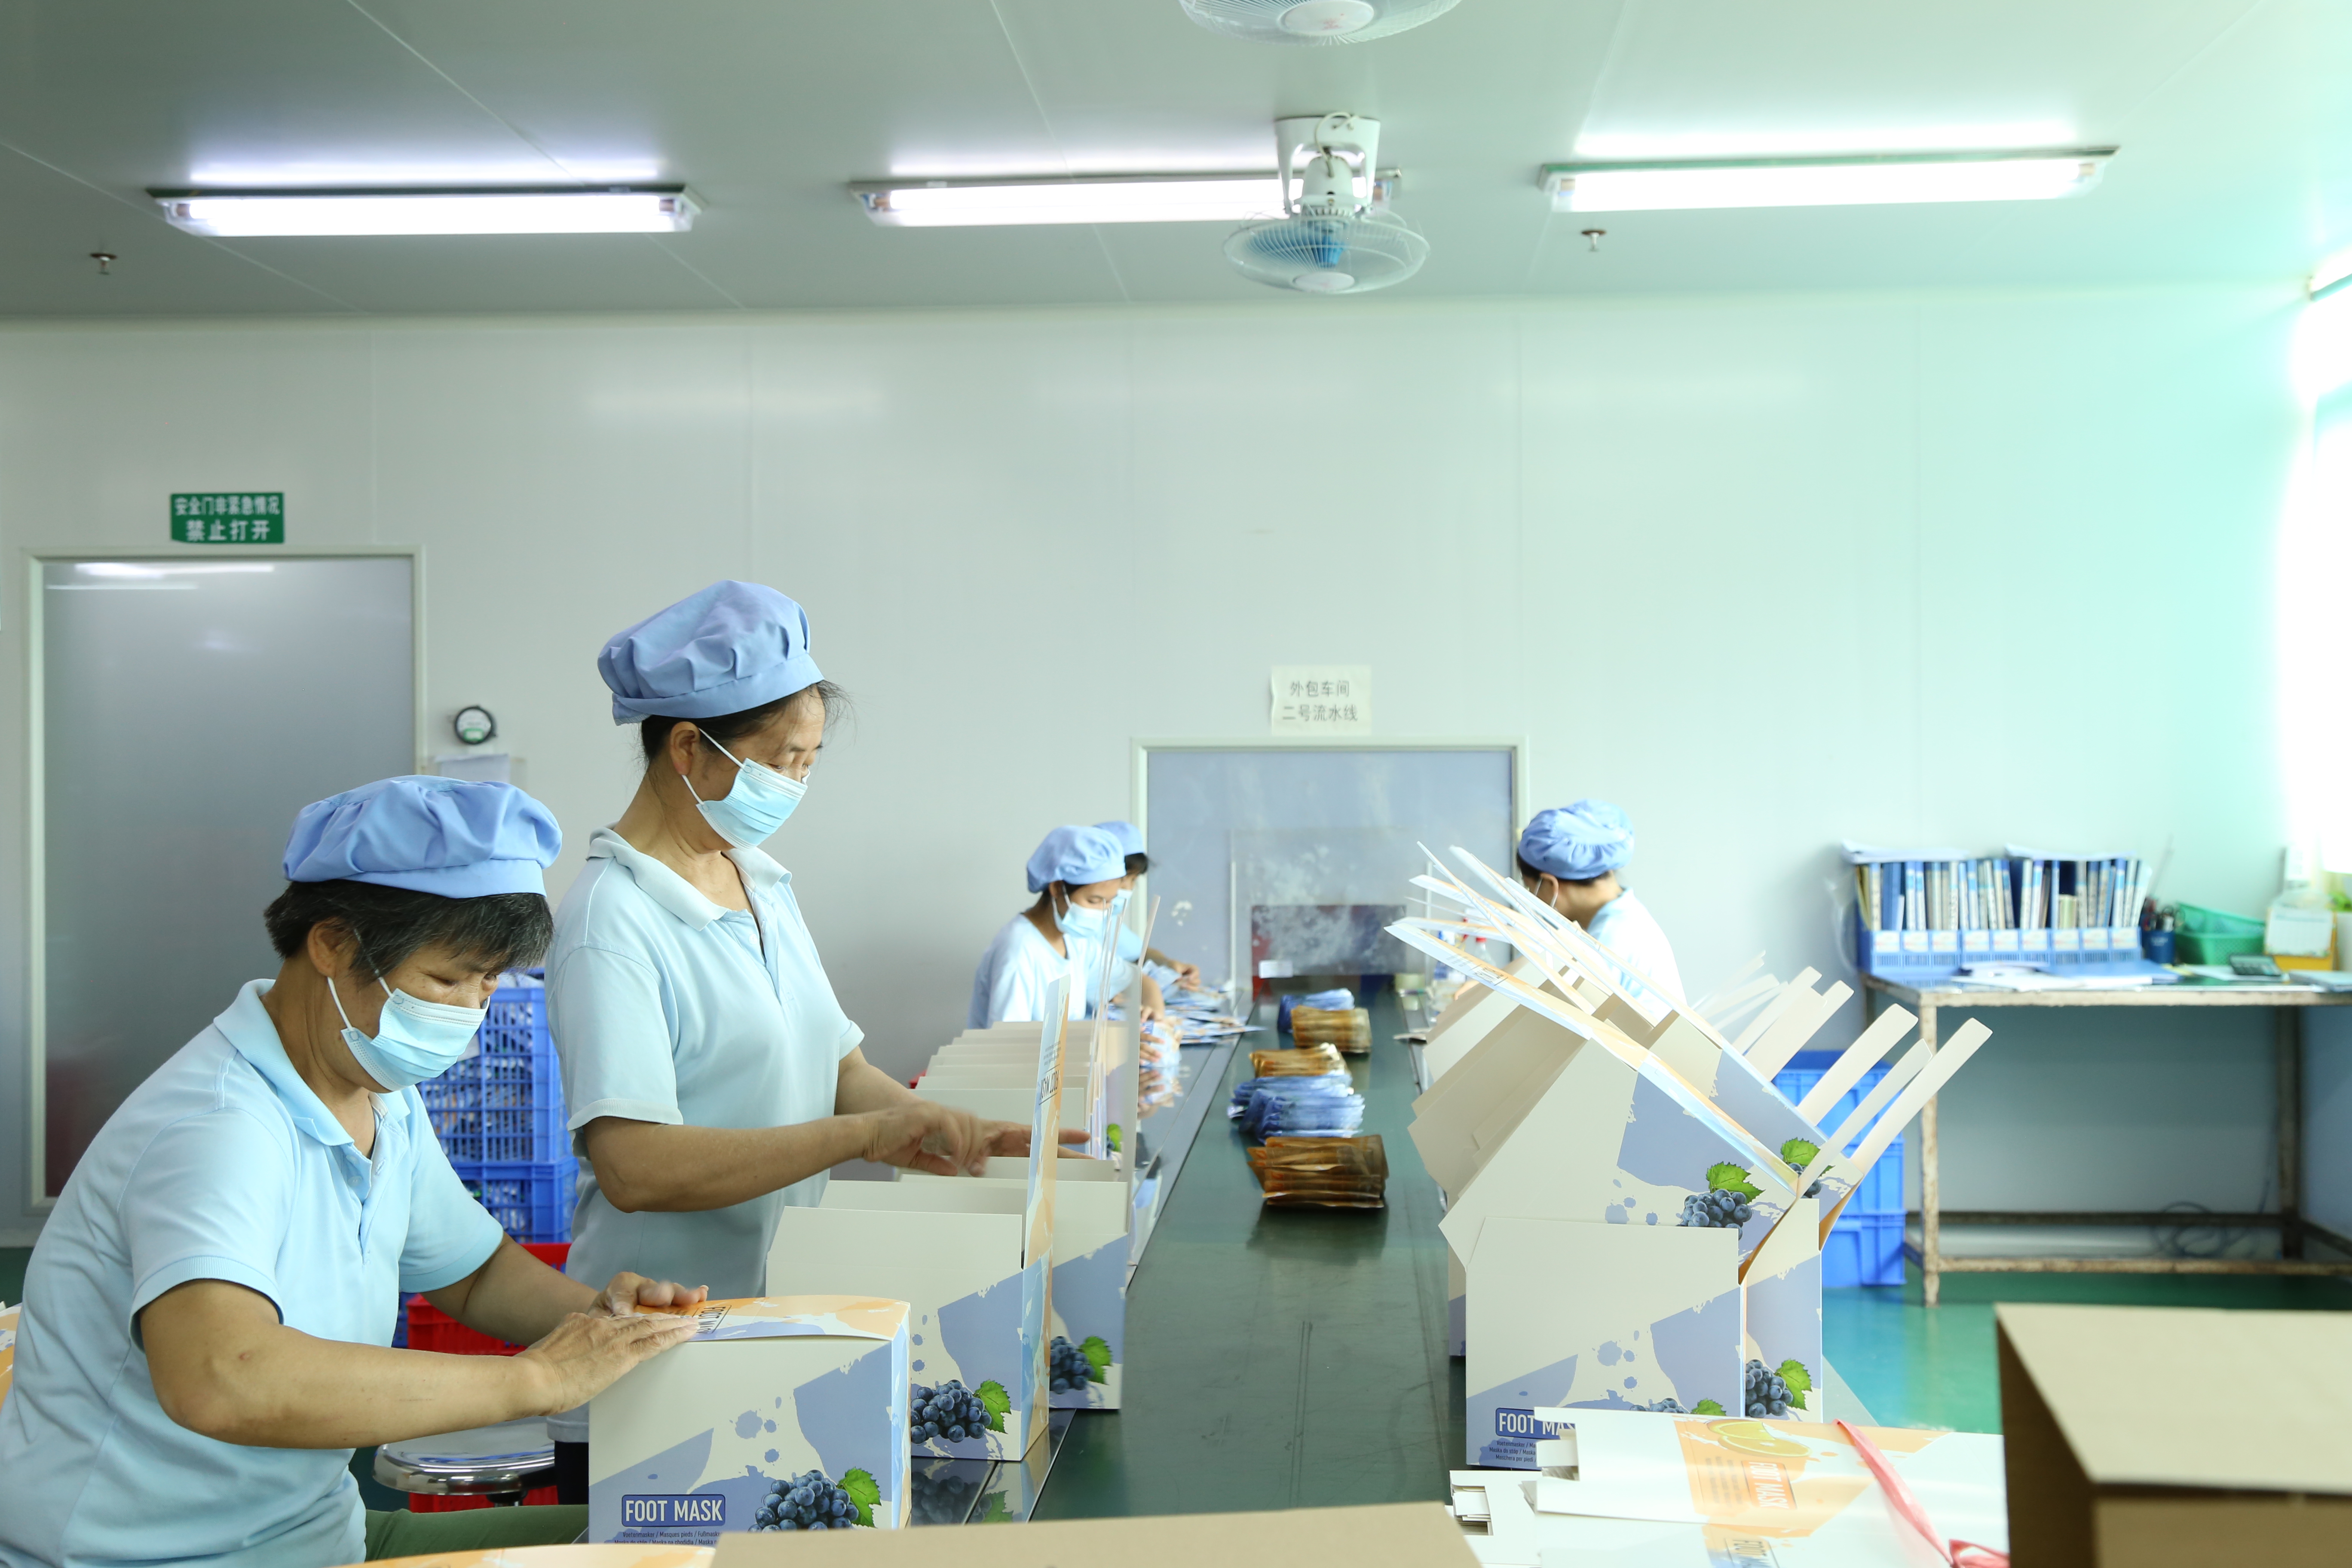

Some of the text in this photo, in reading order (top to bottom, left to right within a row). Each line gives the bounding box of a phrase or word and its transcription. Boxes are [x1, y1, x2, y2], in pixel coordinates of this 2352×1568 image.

[185, 519, 270, 541] 禁止打开
[1290, 680, 1350, 697] 外包车间
[1282, 704, 1358, 722] 二号流水线
[698, 1306, 726, 1319] FOOT
[1499, 1412, 1535, 1434] FOOT
[1749, 1461, 1789, 1509] FOOT MASK
[626, 1499, 723, 1522] FOOT MASK
